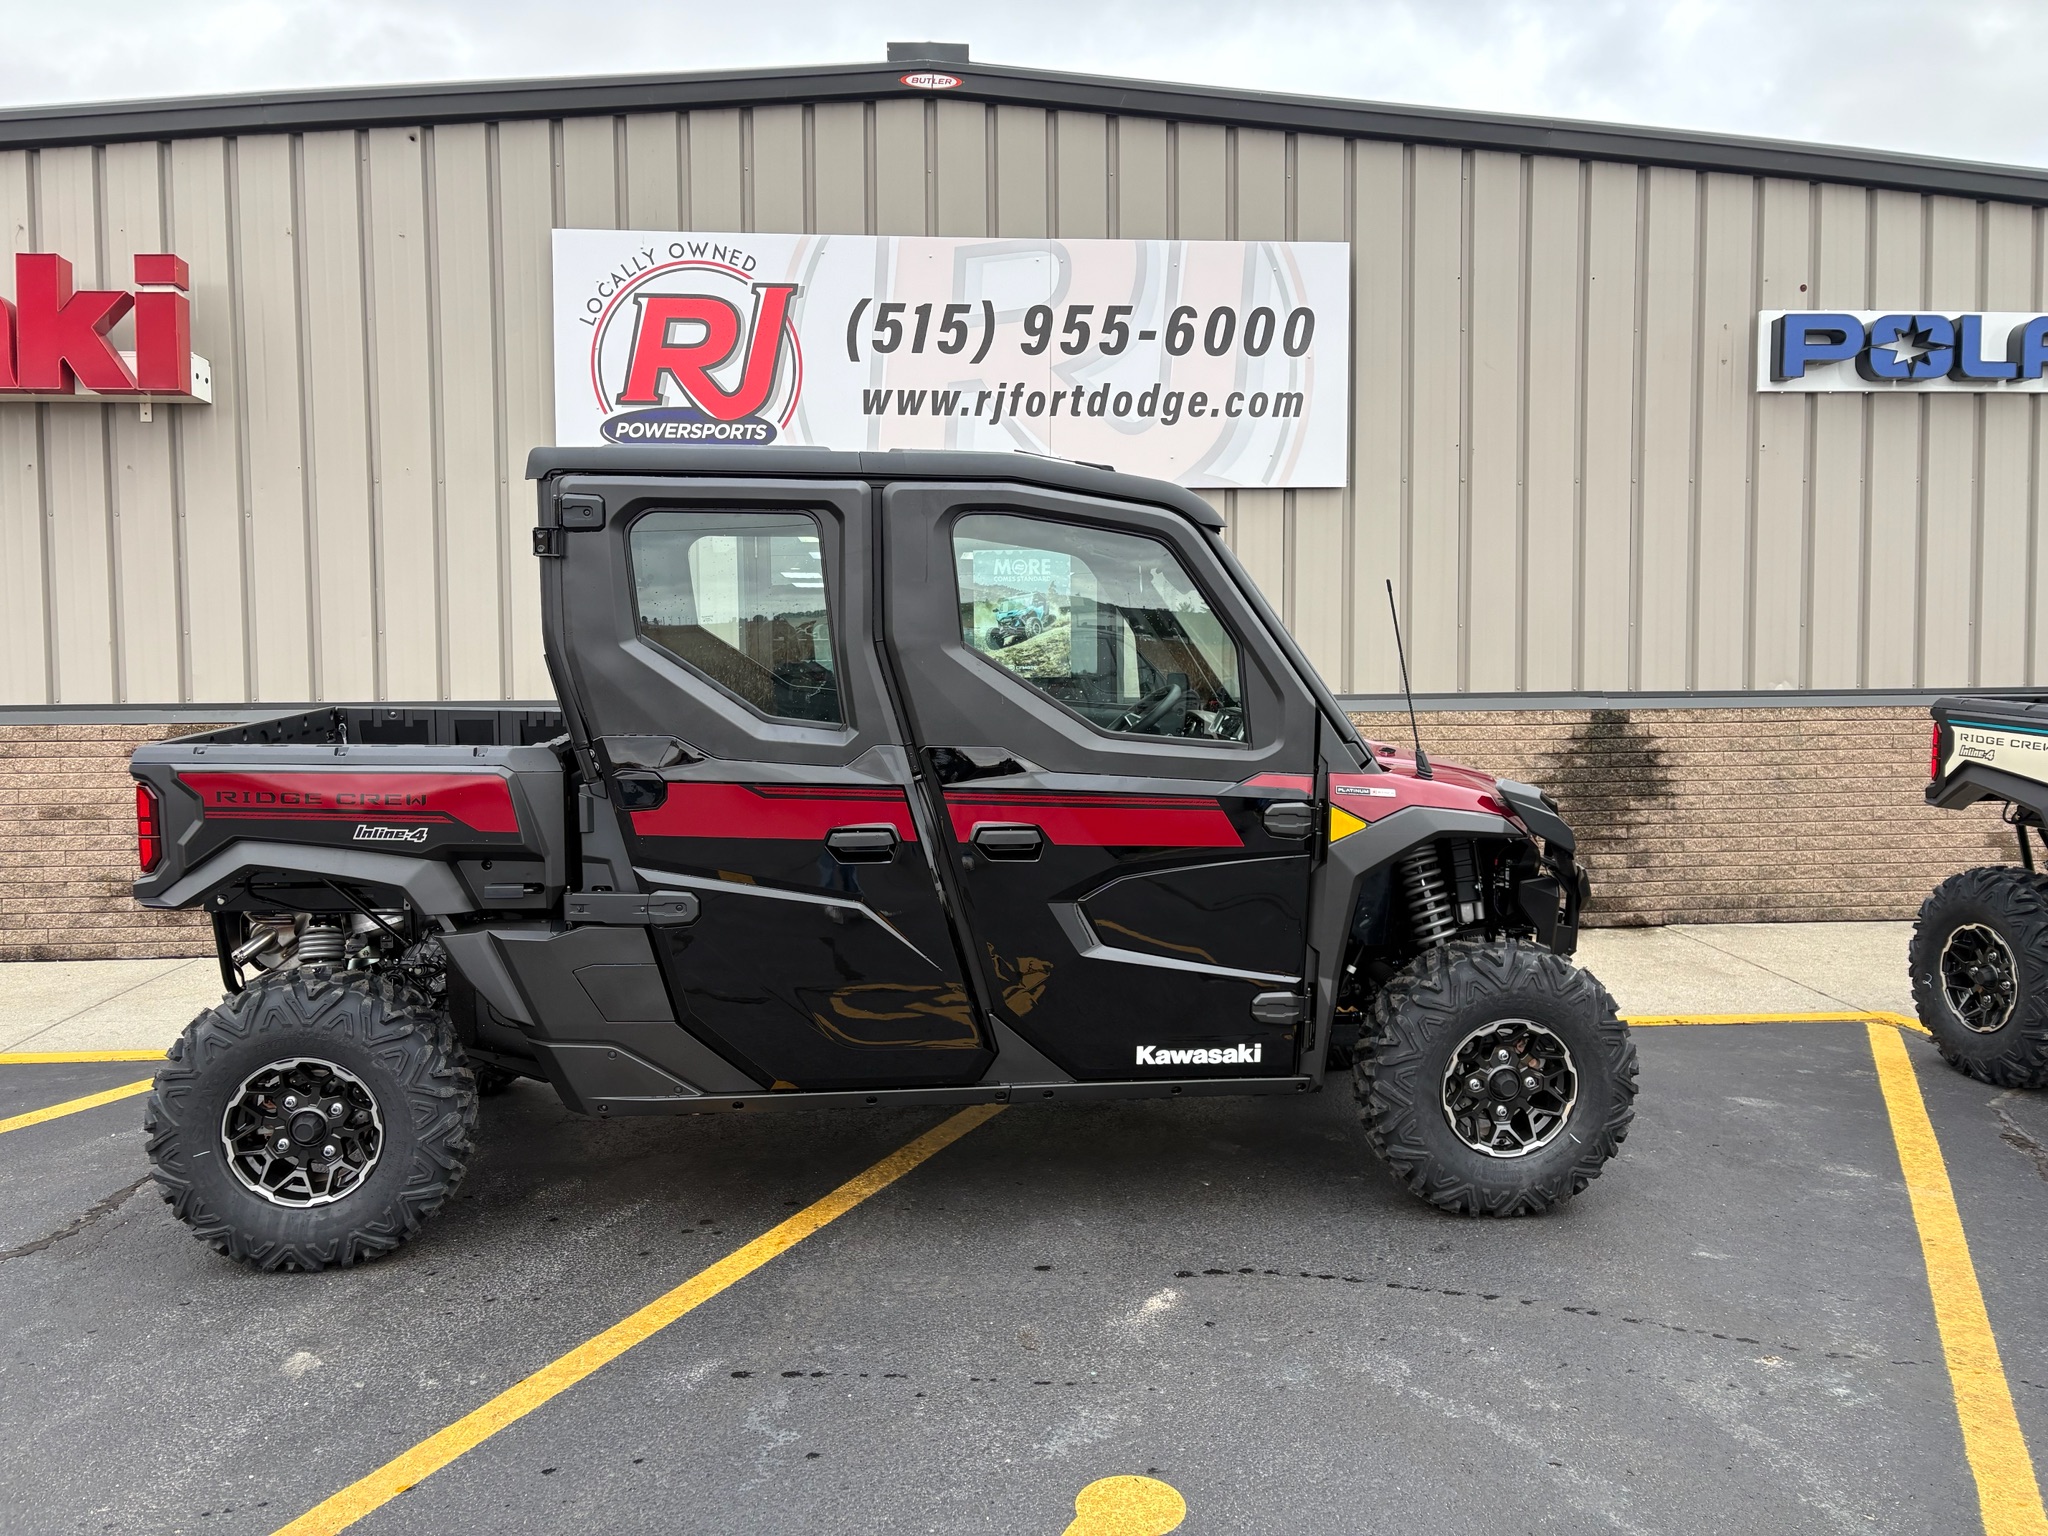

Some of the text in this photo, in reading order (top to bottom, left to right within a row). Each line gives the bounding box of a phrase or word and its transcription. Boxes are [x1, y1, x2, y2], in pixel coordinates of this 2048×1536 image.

[579, 240, 757, 326] LOCALLY OWNED
[0, 252, 191, 395] ki
[846, 297, 1316, 364] (515) 955-6000
[615, 283, 799, 421] RJ
[861, 382, 1305, 426] www.rjfortdodge.com
[615, 422, 768, 440] POWERSPORTS
[993, 558, 1051, 576] MORE
[1960, 733, 2005, 746] RIDGE
[1959, 744, 1996, 761] Inline-4
[216, 791, 427, 806] RIDGE CREW
[353, 824, 429, 843] Inline-4
[1136, 1043, 1262, 1065] Kawasaki
